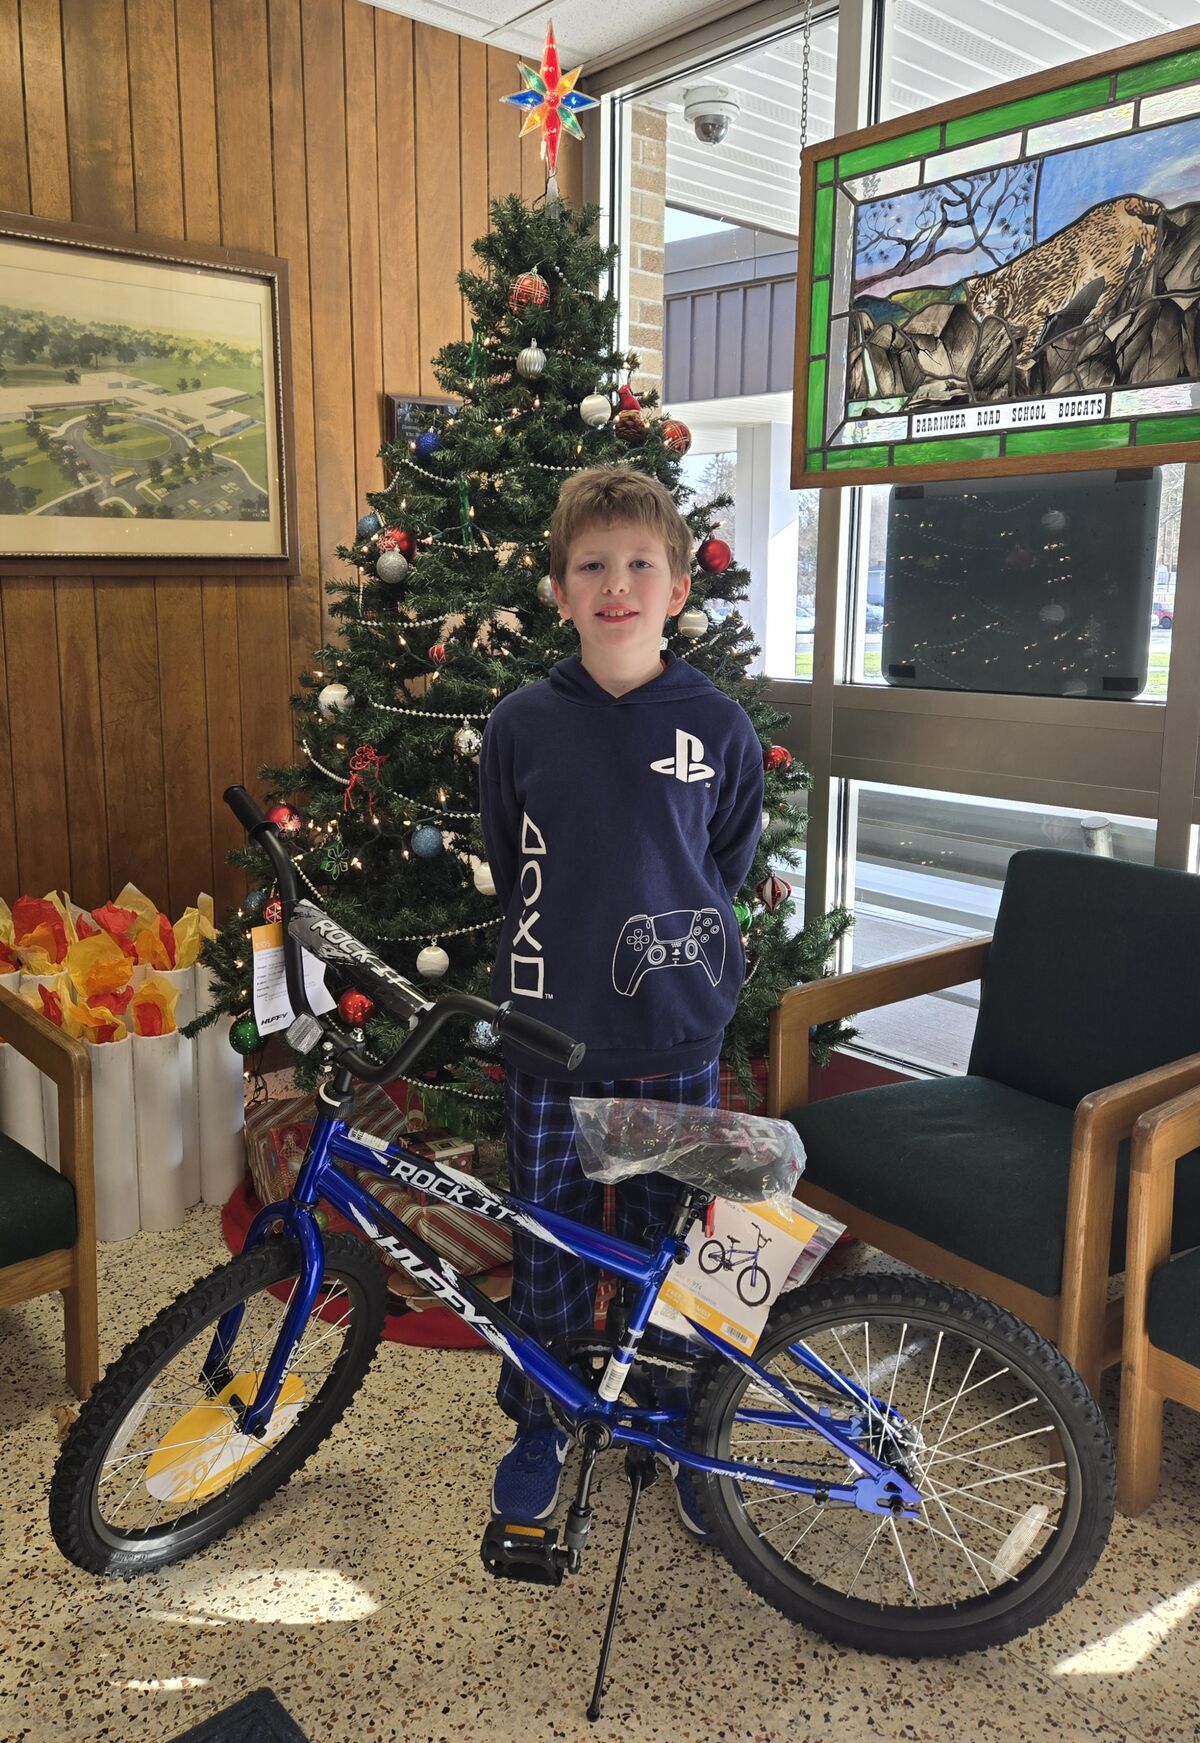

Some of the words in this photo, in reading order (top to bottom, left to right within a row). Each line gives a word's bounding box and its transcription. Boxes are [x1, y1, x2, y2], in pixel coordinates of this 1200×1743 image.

[916, 414, 966, 433] BARRINGER
[977, 409, 1001, 426] ROAD
[1012, 403, 1047, 422] SCHOOL
[1058, 400, 1103, 418] BOBCATS
[312, 919, 374, 963] ROCK
[261, 1012, 288, 1026] HUFFY
[391, 1161, 471, 1204] ROCK
[474, 1197, 516, 1221] IT
[376, 1235, 493, 1325] HUFFY
